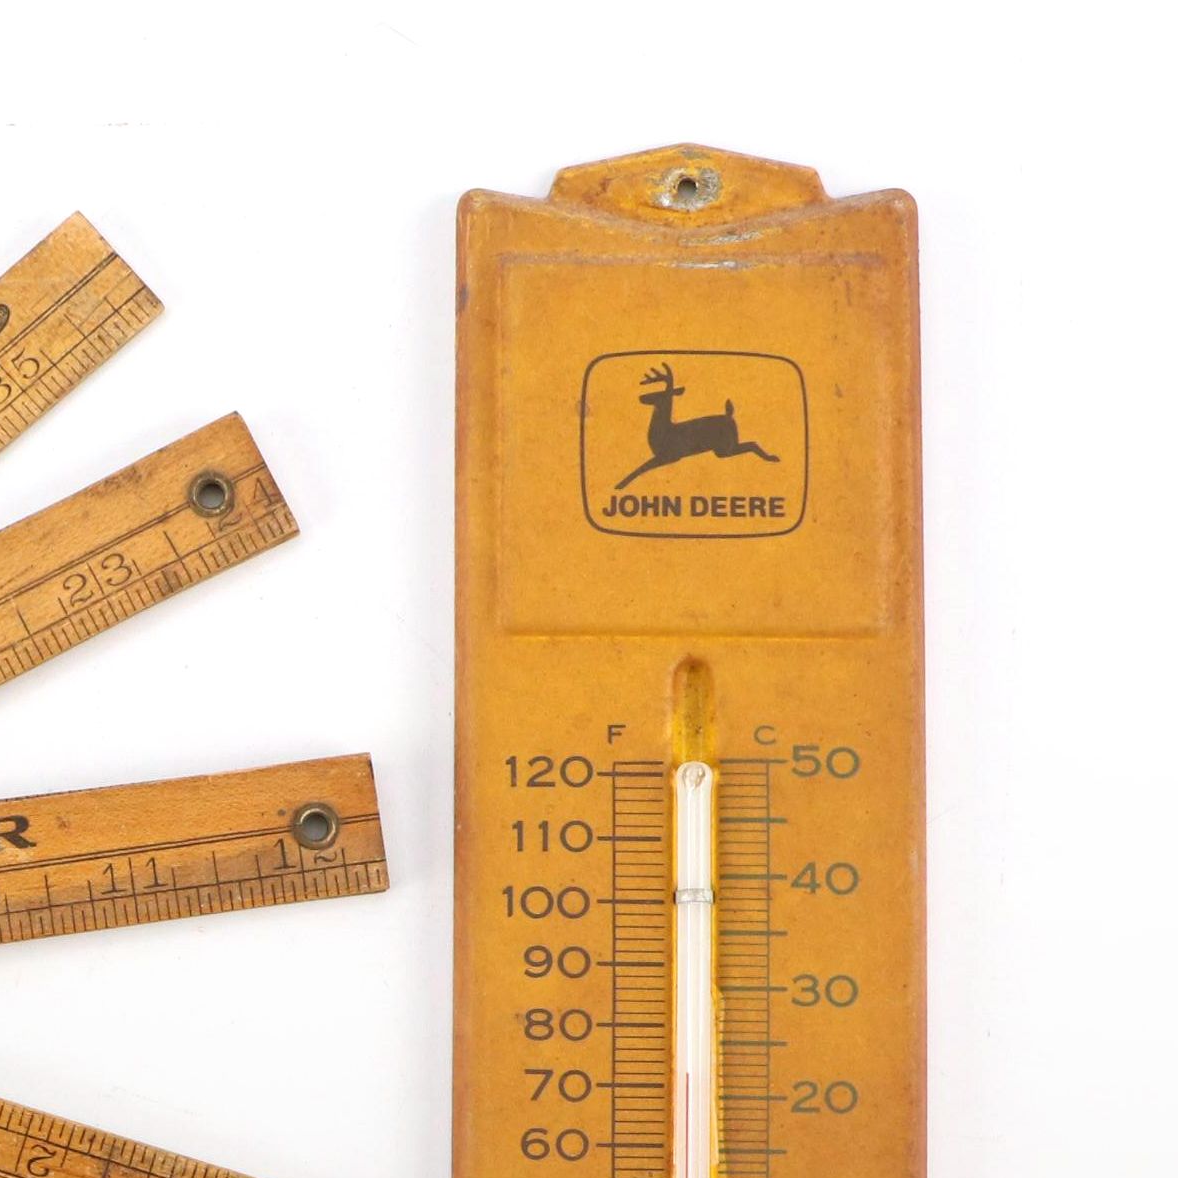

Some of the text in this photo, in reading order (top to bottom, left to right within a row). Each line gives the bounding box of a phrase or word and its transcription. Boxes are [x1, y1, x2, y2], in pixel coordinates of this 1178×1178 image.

[602, 495, 786, 519] JOHN DEERE
[64, 552, 133, 605] 23
[607, 725, 626, 744] F
[754, 725, 776, 745] C
[506, 756, 594, 788] 120
[791, 747, 860, 778] 50
[512, 820, 593, 853] 110
[101, 856, 167, 895] 11
[790, 862, 859, 894] 40
[502, 887, 590, 919] 100
[523, 946, 591, 978] 90
[790, 974, 859, 1008] 30
[524, 1008, 593, 1041] 80
[523, 1069, 592, 1102] 70
[790, 1080, 858, 1113] 20
[26, 1144, 56, 1178] 2
[521, 1128, 590, 1161] 60
